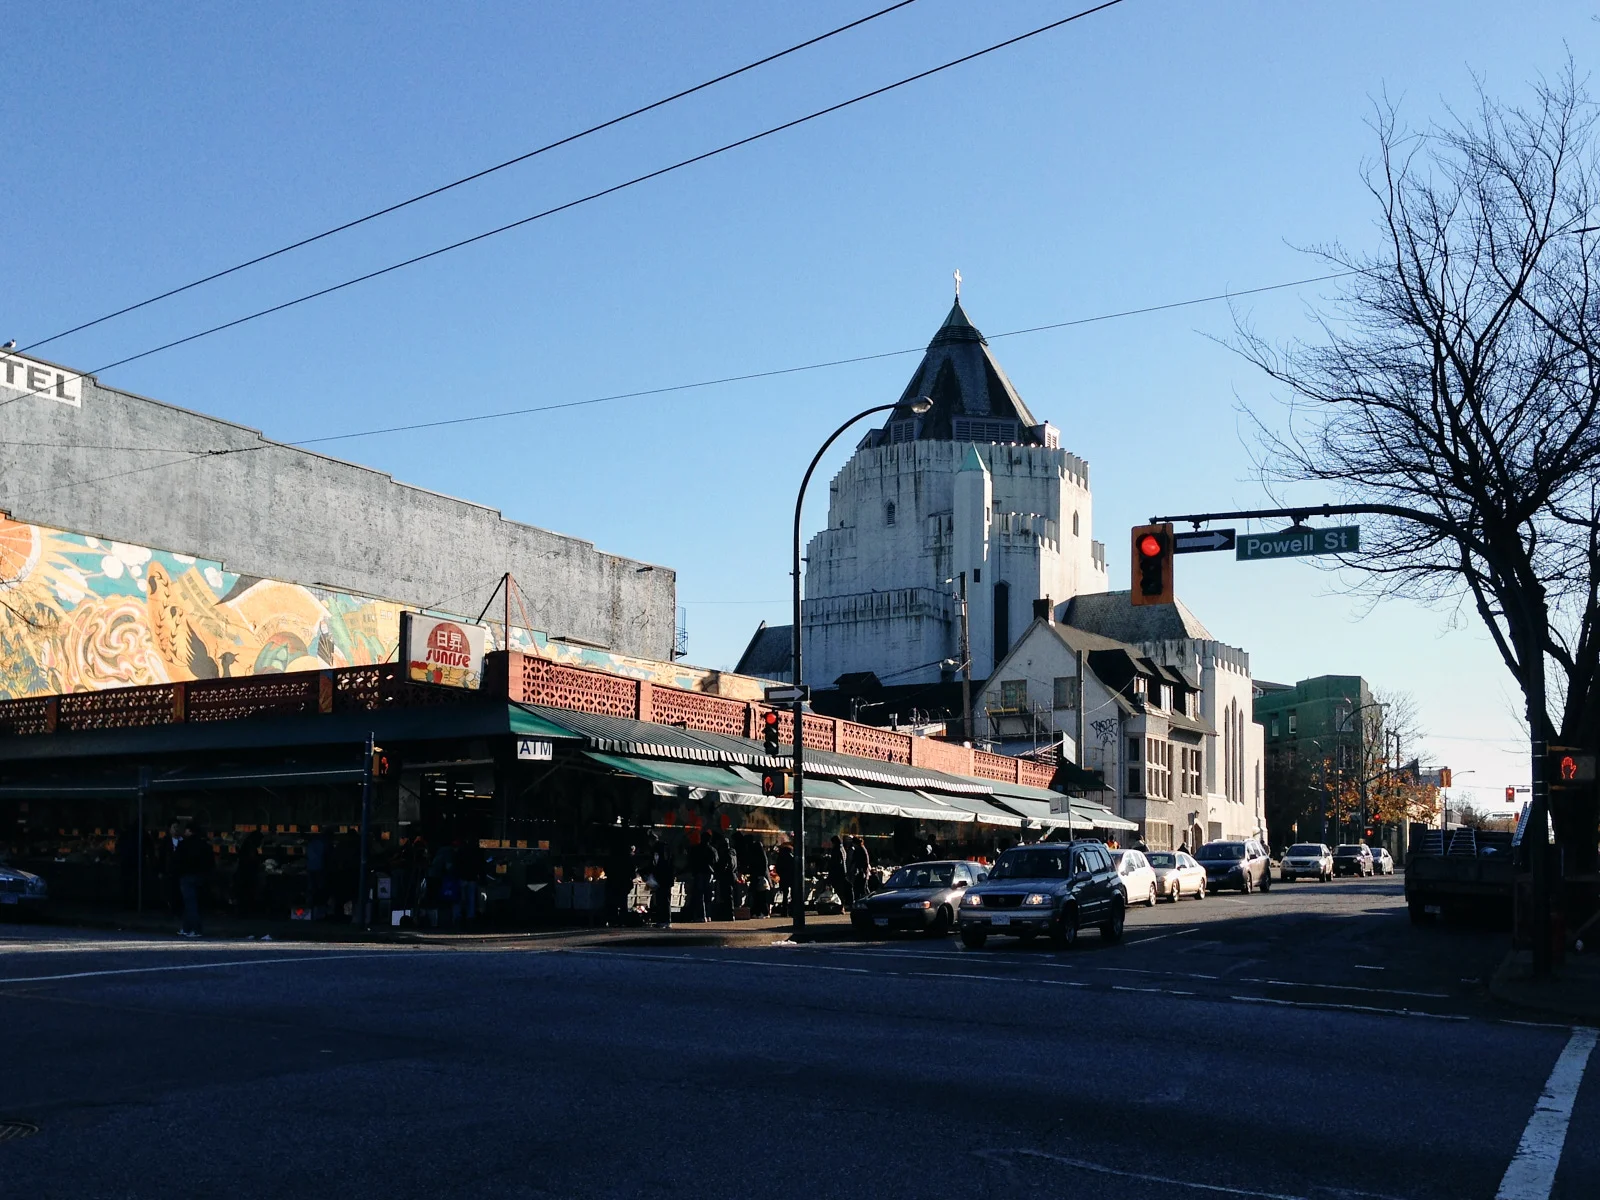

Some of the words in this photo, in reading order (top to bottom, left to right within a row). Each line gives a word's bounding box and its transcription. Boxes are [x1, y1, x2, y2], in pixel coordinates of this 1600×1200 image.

[1247, 534, 1314, 556] Powell
[1324, 532, 1347, 549] St
[519, 739, 551, 756] ATM
